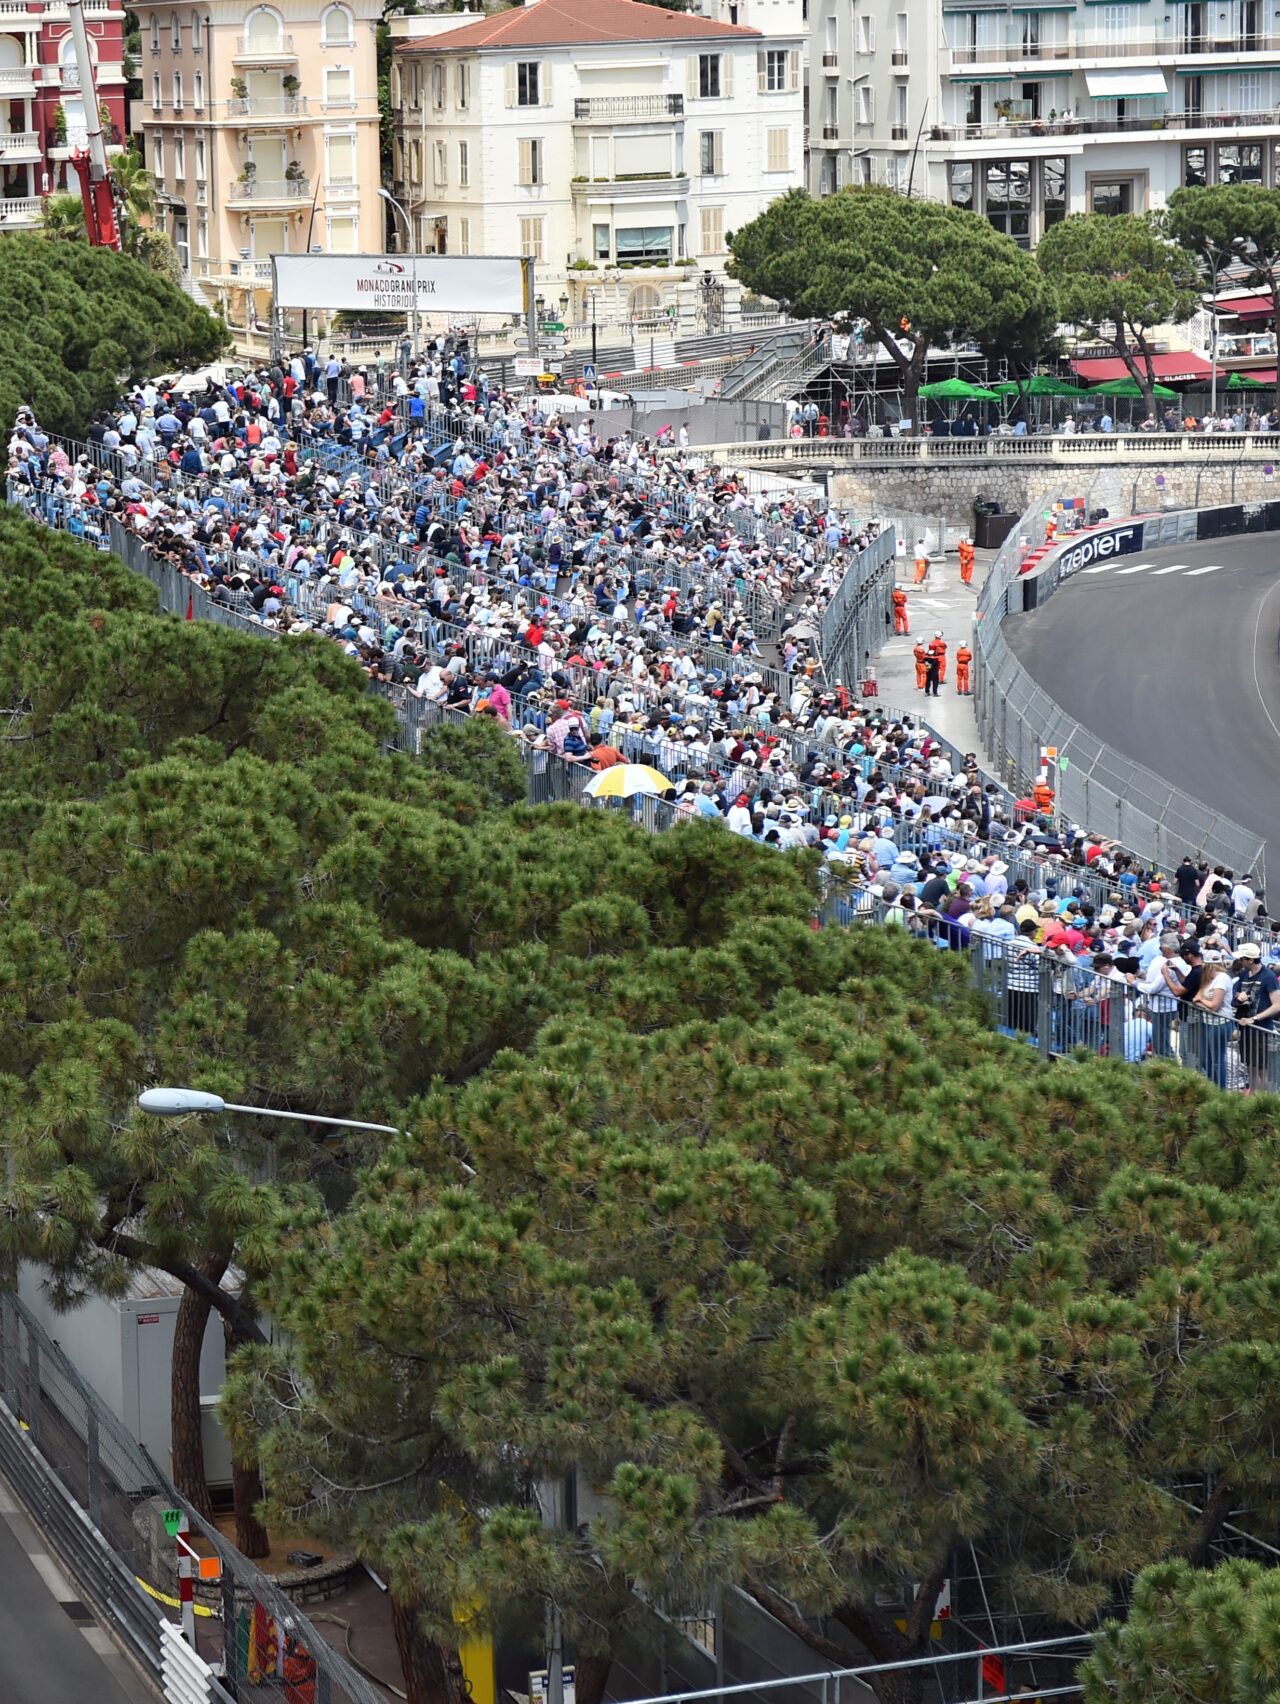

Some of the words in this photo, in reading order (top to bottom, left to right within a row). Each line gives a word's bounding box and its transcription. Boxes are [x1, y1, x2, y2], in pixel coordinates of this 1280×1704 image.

[356, 279, 389, 292] MONACO
[417, 280, 436, 293] PRIX
[1164, 373, 1196, 382] GLACIER
[1064, 527, 1134, 574] zepter
[845, 856, 853, 865] 5
